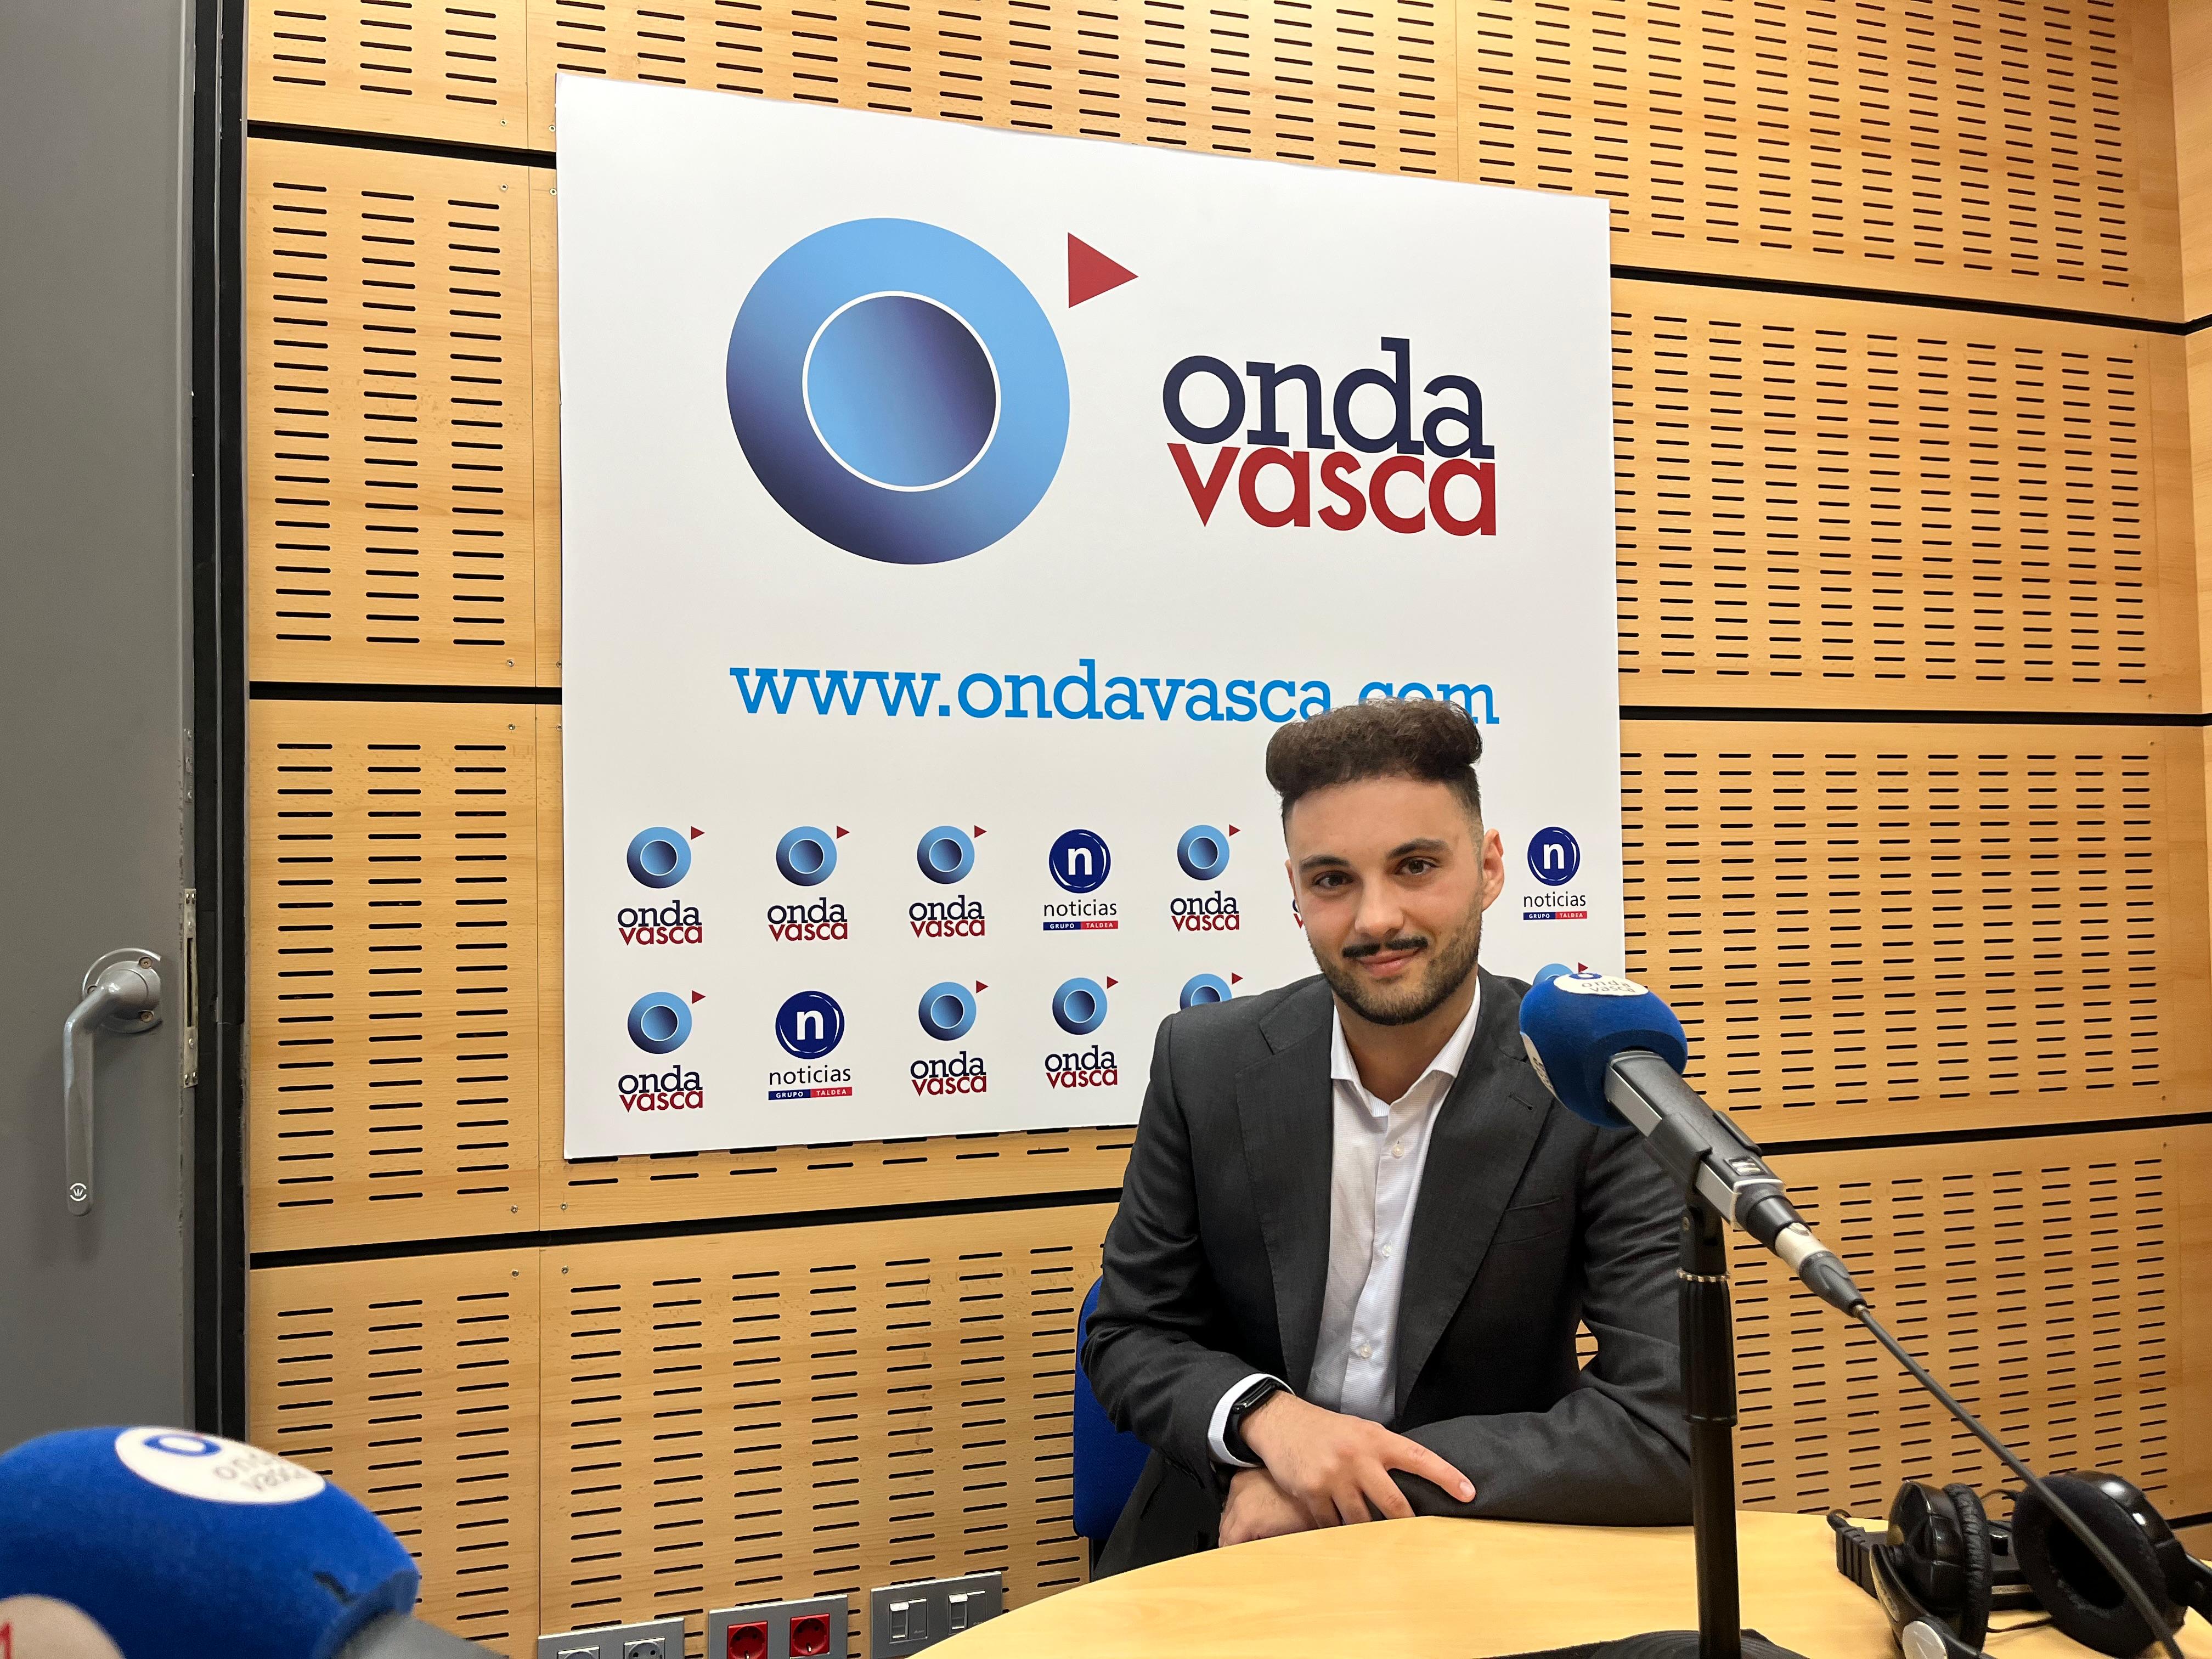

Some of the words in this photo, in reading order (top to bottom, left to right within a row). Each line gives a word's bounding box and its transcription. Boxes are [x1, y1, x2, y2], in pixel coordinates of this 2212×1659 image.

[1163, 336, 1495, 459] onda
[1167, 443, 1497, 537] vasca
[730, 658, 1500, 725] www.ondavascam
[909, 895, 985, 921] onda
[1044, 899, 1117, 917] noticias
[1170, 891, 1239, 915] onda
[1523, 891, 1586, 907] noticias
[617, 900, 702, 928] onda
[767, 898, 848, 924] onda
[1171, 913, 1240, 932] vasca
[618, 926, 703, 946] vasca
[769, 922, 848, 942] vasca
[911, 919, 985, 938] vasca
[1581, 980, 1632, 988] onda
[910, 1051, 986, 1078] onda
[1045, 1045, 1117, 1071] onda
[618, 1065, 703, 1094] onda
[770, 1065, 851, 1085] noticias
[912, 1075, 987, 1097] vasca
[1047, 1069, 1118, 1089] vasca
[620, 1090, 703, 1113] vasca
